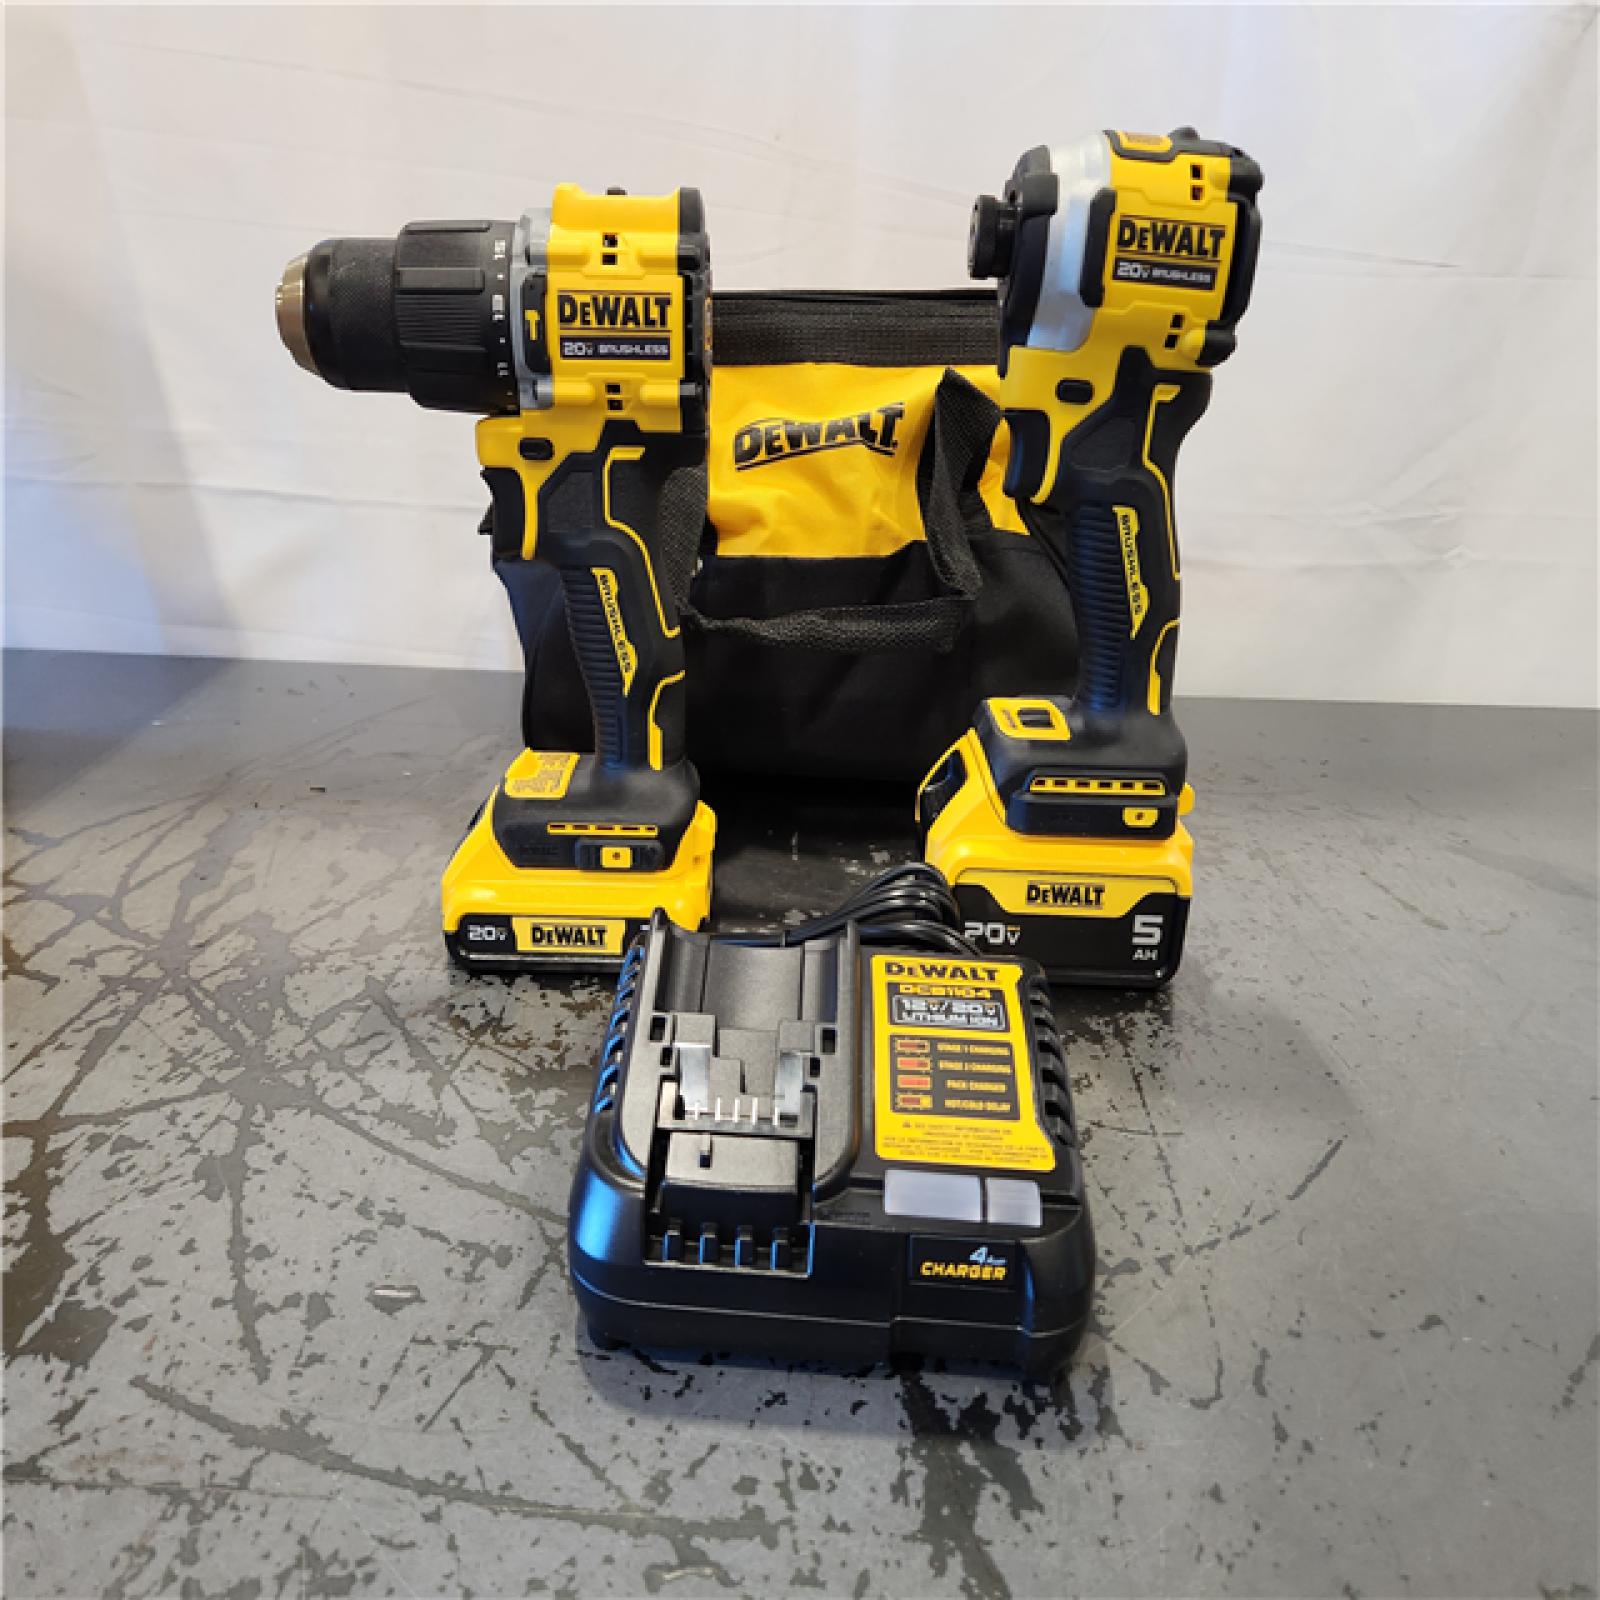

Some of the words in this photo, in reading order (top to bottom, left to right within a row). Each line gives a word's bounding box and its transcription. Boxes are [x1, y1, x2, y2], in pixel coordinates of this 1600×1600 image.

[1152, 267, 1211, 283] BRUSHLESS
[598, 343, 669, 355] BRUSHLESS
[1132, 914, 1164, 945] 5
[969, 1246, 989, 1264] 4
[920, 1262, 1007, 1281] CHARGER
